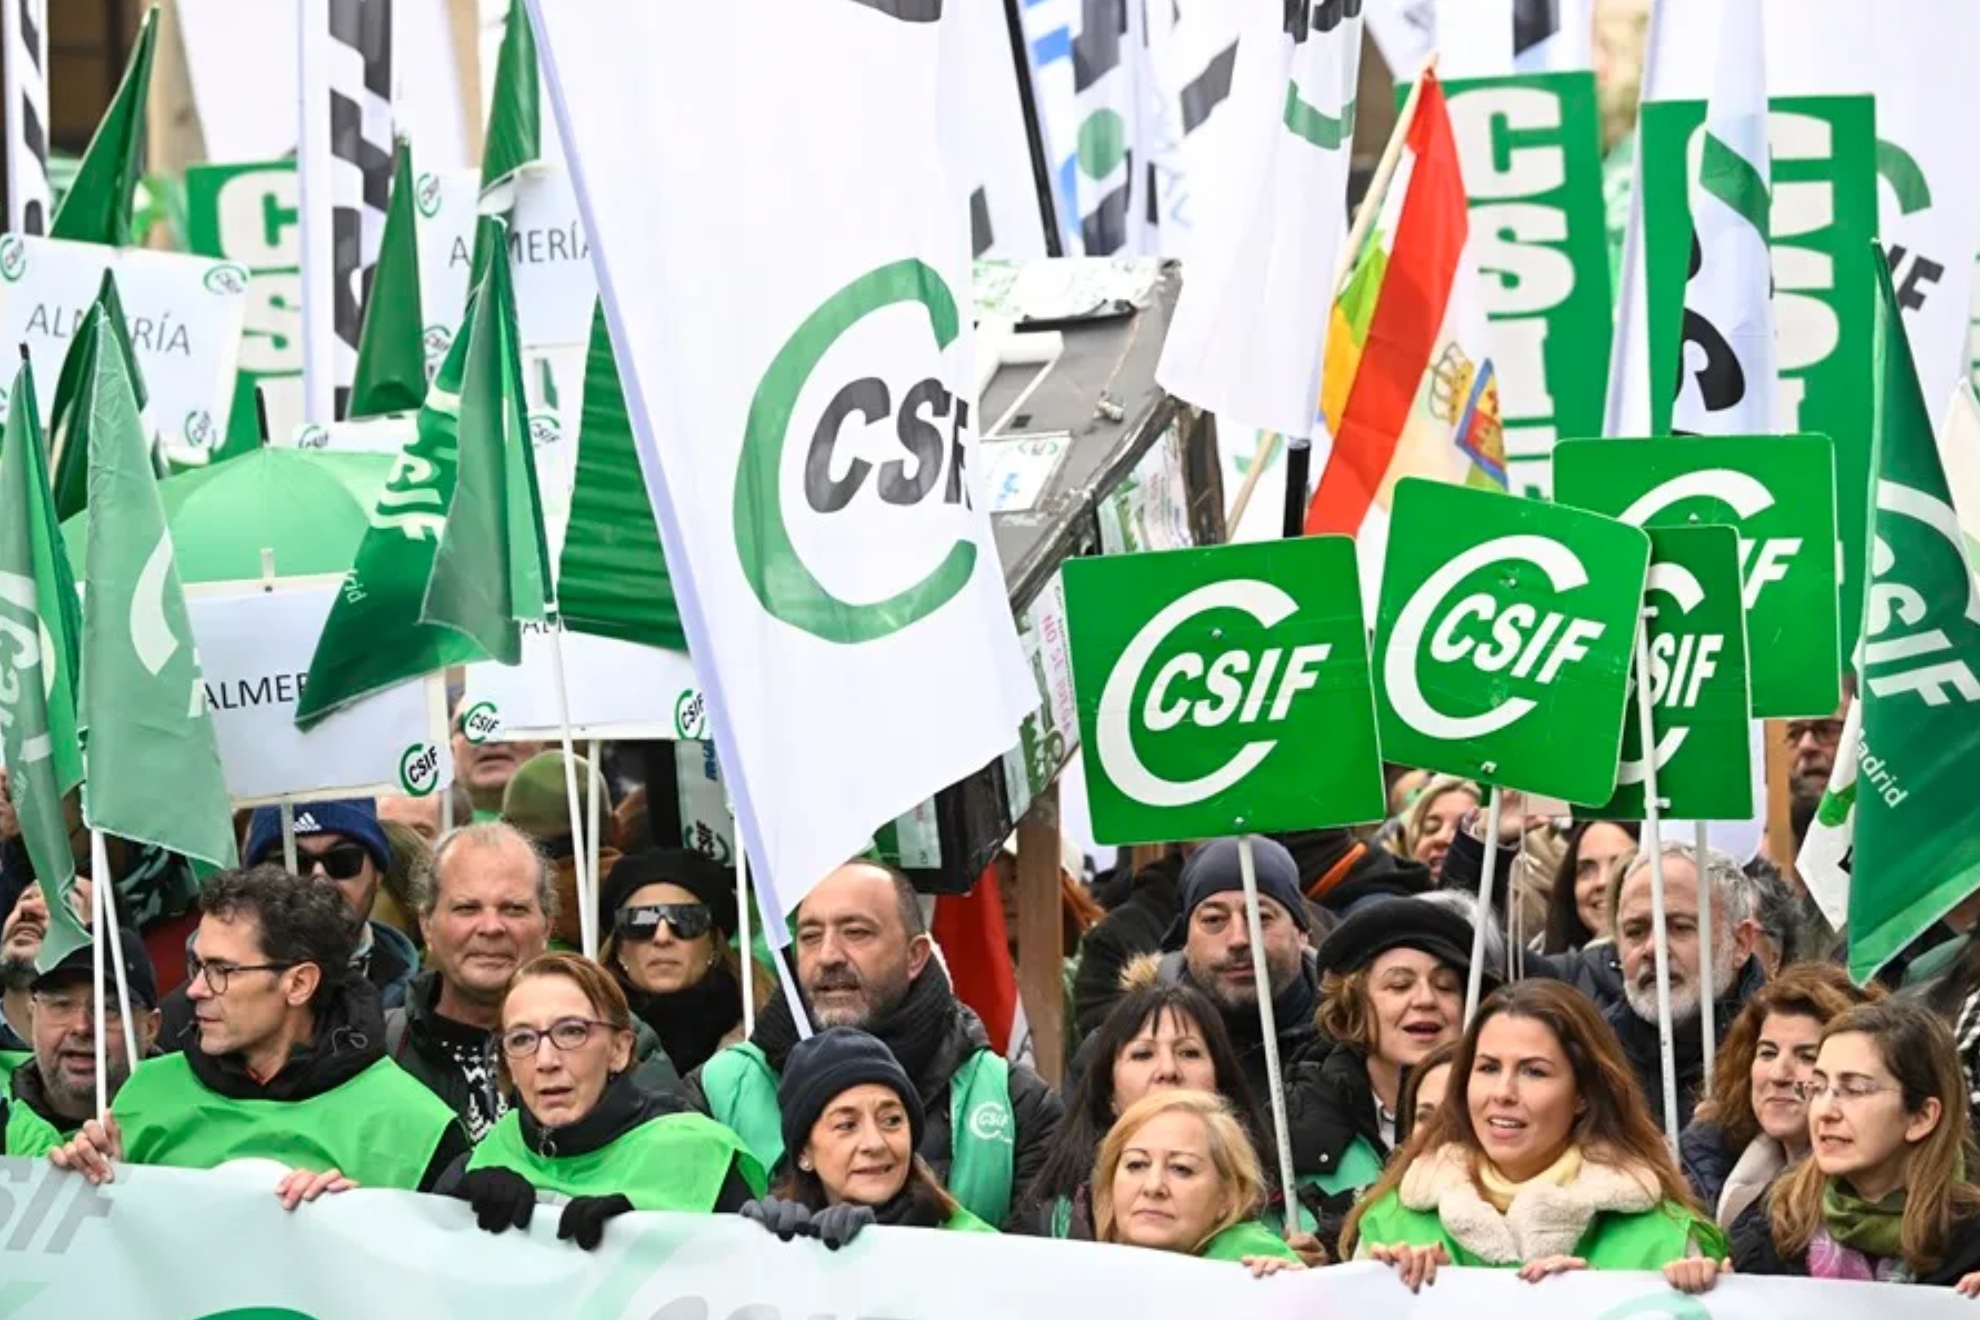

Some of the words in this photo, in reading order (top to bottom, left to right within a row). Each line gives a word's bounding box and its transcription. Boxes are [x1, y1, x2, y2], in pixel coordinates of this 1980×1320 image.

[25, 303, 191, 356] ALRÍA
[1430, 593, 1606, 685] CSIF
[1628, 633, 1724, 707] SIF
[468, 713, 500, 734] CSIF
[1143, 643, 1332, 731] CSIF
[408, 746, 438, 784] CSIF
[1857, 728, 1909, 809] adrid
